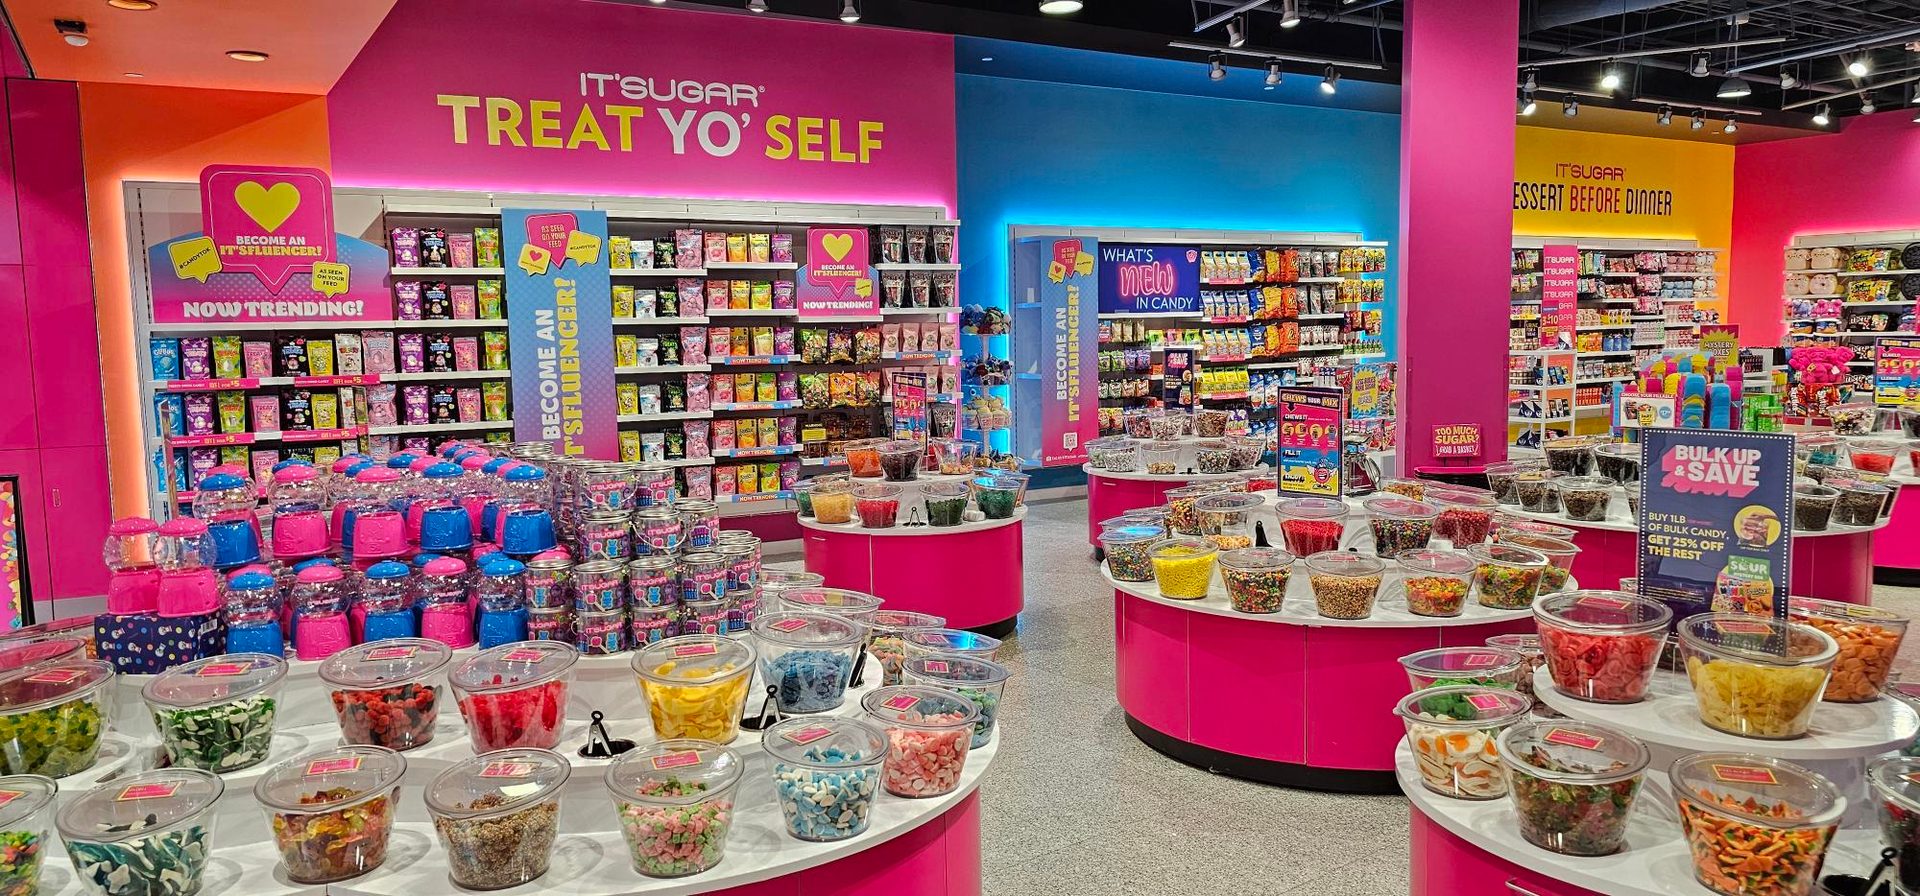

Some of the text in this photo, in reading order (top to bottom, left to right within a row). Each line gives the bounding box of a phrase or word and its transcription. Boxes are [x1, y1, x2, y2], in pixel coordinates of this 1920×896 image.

[436, 93, 884, 164] TREAT YO' SELF
[1513, 181, 1672, 217] ESSERT BEFORE DINNER
[236, 235, 306, 246] BECOME AN
[219, 244, 322, 258] IT'SFLUENCER!
[1103, 247, 1154, 263] WHAT'S
[316, 274, 345, 283] ON YOUR
[318, 268, 344, 277] AS SEEN
[322, 280, 338, 288] FEED
[183, 299, 365, 318] NOW TRENDING!
[803, 300, 874, 310] NOW TRENDING!
[1136, 296, 1194, 310] IN CANDY
[1703, 340, 1735, 349] MYSTERY
[1055, 306, 1068, 401] BECOME AN
[1066, 283, 1081, 422] IT'SFLUENCER!
[535, 309, 562, 440] BECOME AN
[1281, 393, 1307, 404] CHEWS
[1321, 396, 1339, 408] MIX
[1434, 425, 1478, 435] TOO MUCH
[1434, 434, 1480, 445] SUGAR?
[1674, 444, 1763, 465] BULK UP
[1674, 461, 1761, 487] & SAVE
[1648, 511, 1669, 522] BUY
[1669, 513, 1687, 524] 1LB
[1648, 522, 1663, 533] OF
[1663, 524, 1690, 536] BULK
[1647, 534, 1672, 546] GET
[1672, 536, 1698, 549] 25%
[1700, 539, 1726, 552] OFF
[1647, 545, 1703, 562] THE REST
